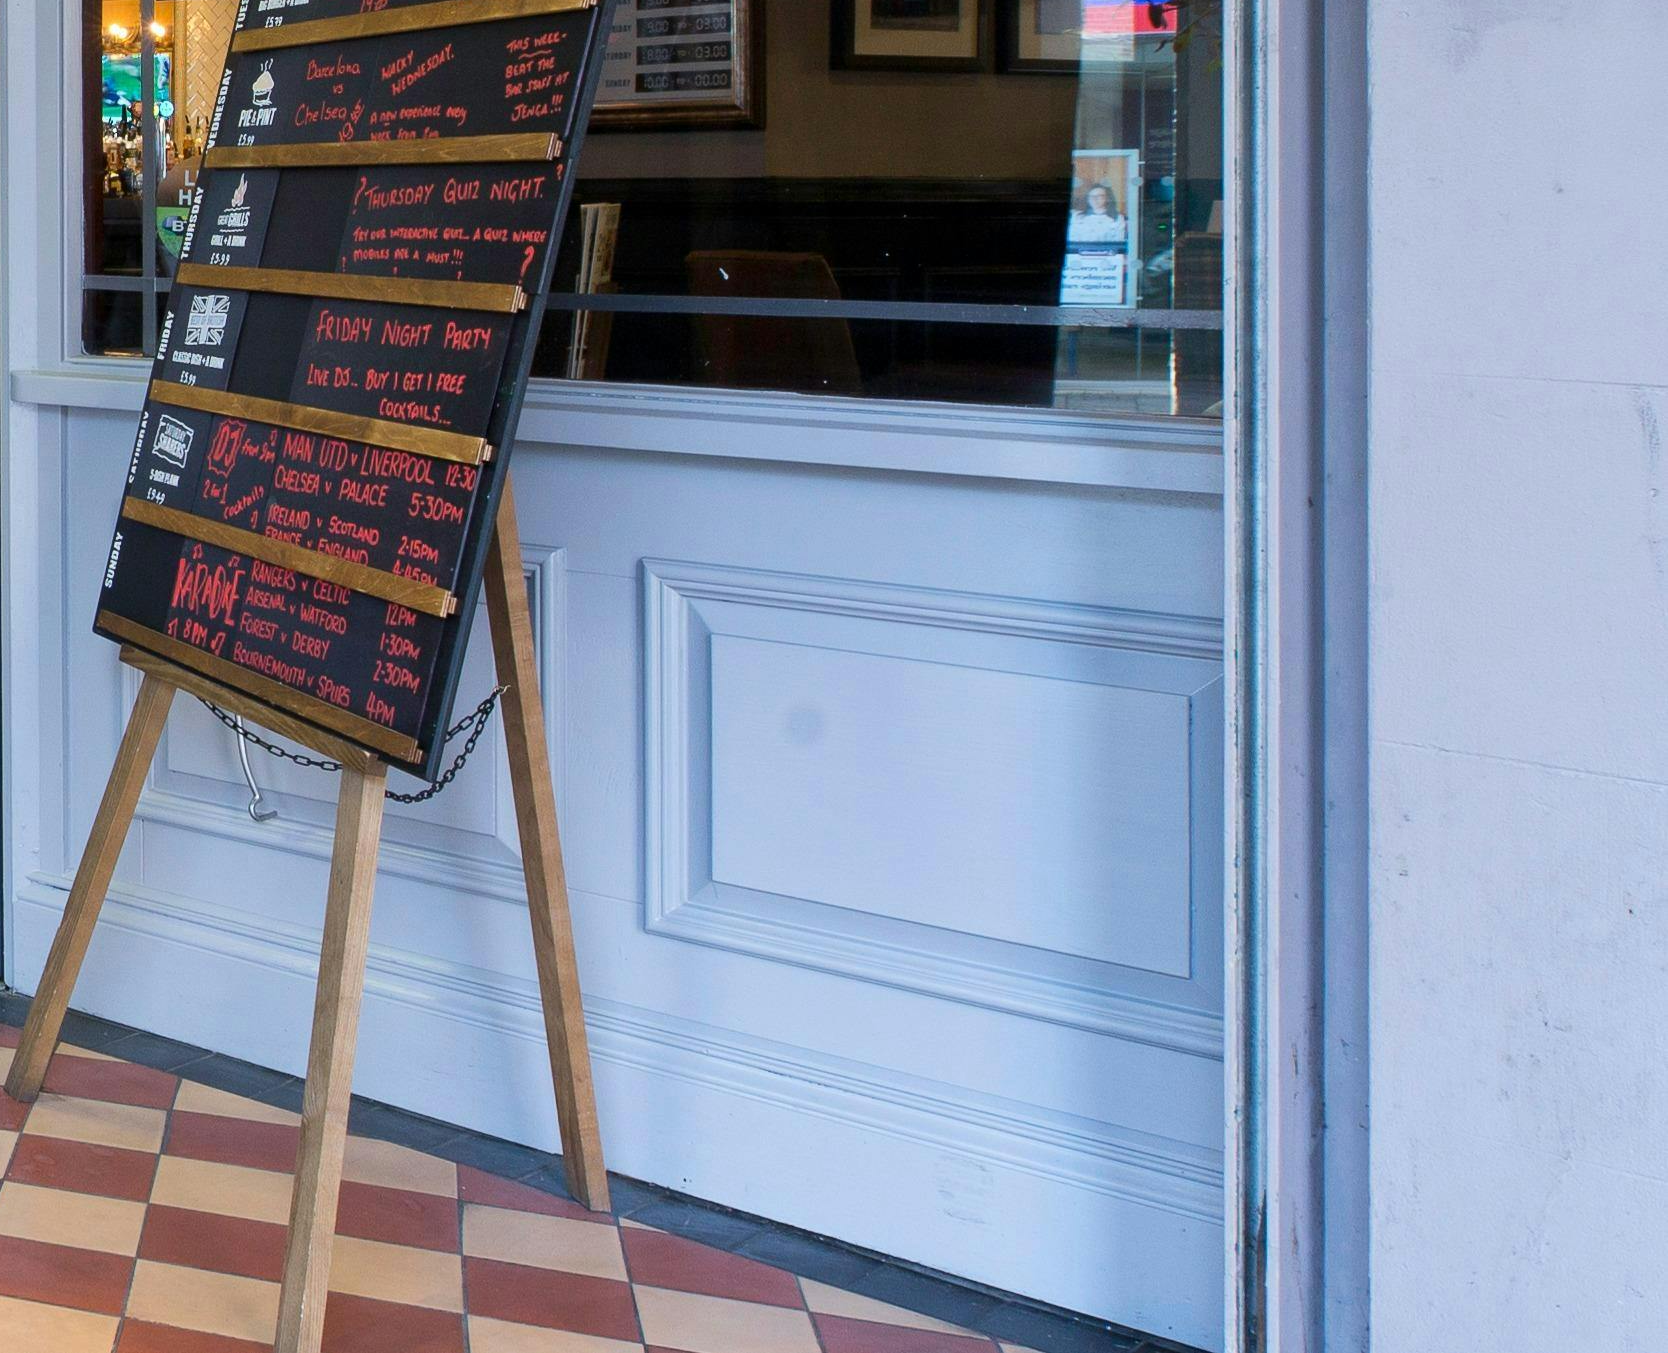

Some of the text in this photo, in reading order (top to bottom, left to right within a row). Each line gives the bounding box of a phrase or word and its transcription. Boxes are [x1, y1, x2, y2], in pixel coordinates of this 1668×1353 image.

[206, 68, 233, 154] WEDNESDAY
[295, 100, 347, 127] Chelsea
[365, 183, 435, 212] THURSDAY
[181, 186, 205, 261] THURSDAY
[157, 310, 175, 361] FRIDAY
[316, 309, 492, 351] FRIDAY NIGHT PARTY
[307, 363, 467, 396] LIVE BUY GET FREE
[283, 432, 315, 463] MAN
[319, 438, 348, 472] UTD
[360, 446, 435, 486] LIVERPOOL
[273, 464, 320, 497] CHELSEA
[337, 479, 389, 508] PALACE
[267, 502, 311, 530] IRELAND
[328, 515, 380, 546] SCOTLAND
[104, 531, 124, 589] SUNDAY
[250, 560, 297, 592] RANGERS
[171, 557, 246, 626] KARAOKE
[240, 611, 279, 644] FOREST
[292, 630, 331, 661] DERBY
[300, 602, 347, 636] WATFORD
[232, 641, 307, 687] BOURNEMOUTH
